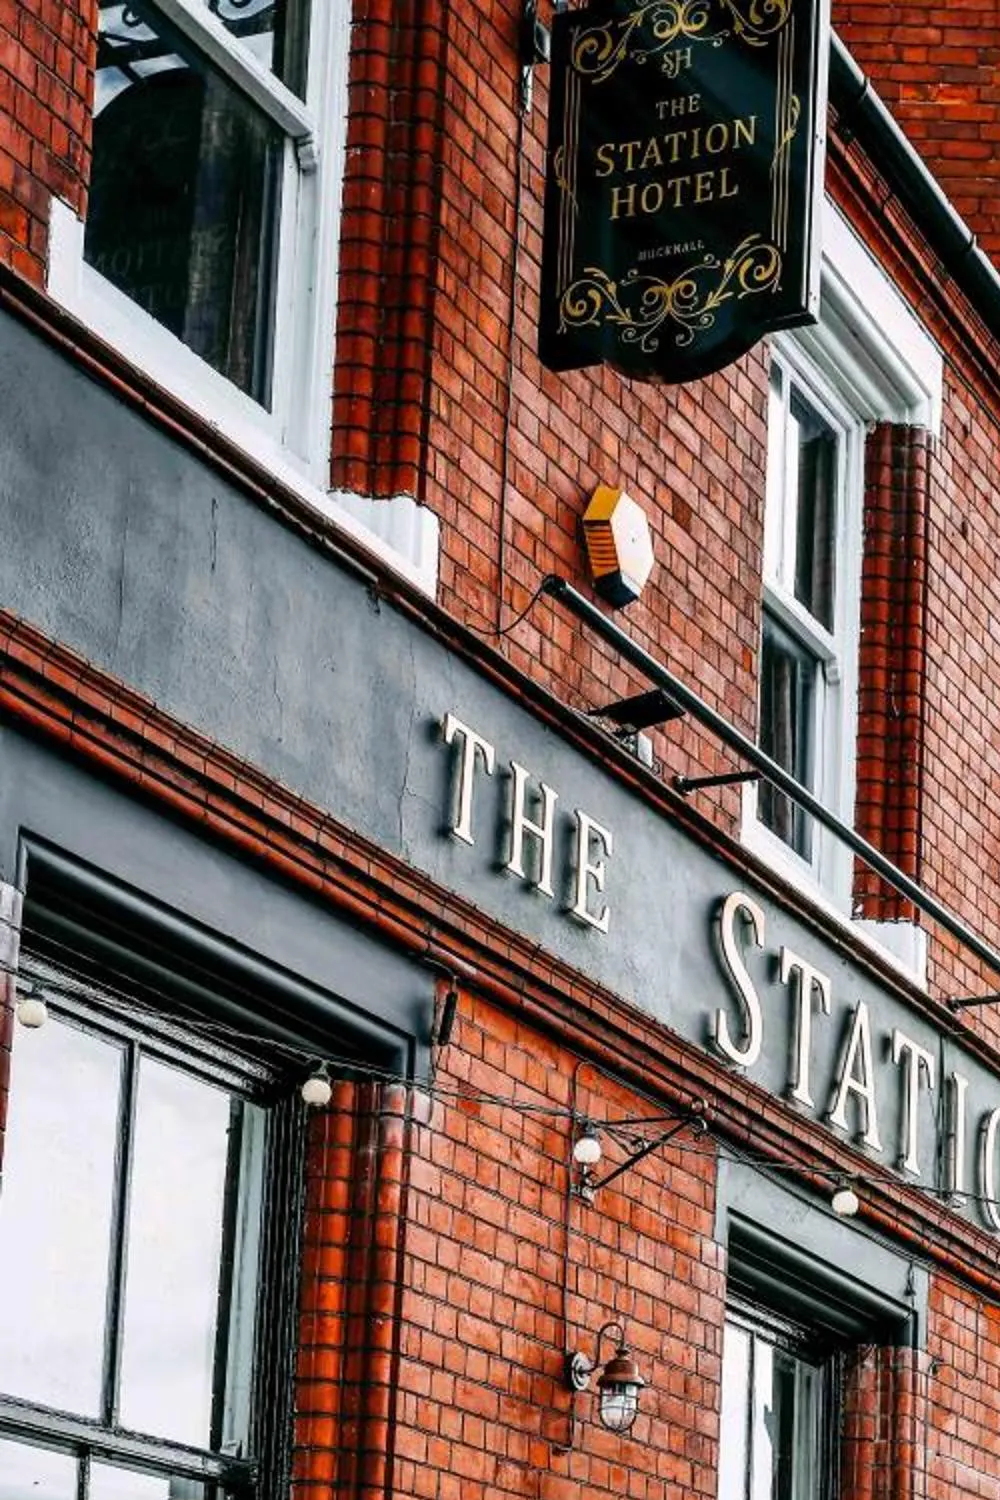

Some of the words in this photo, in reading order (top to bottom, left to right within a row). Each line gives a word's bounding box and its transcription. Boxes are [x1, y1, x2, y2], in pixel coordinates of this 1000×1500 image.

[655, 94, 701, 121] THE
[595, 115, 758, 178] STATION
[610, 167, 740, 221] HOTEL
[443, 712, 615, 935] THE
